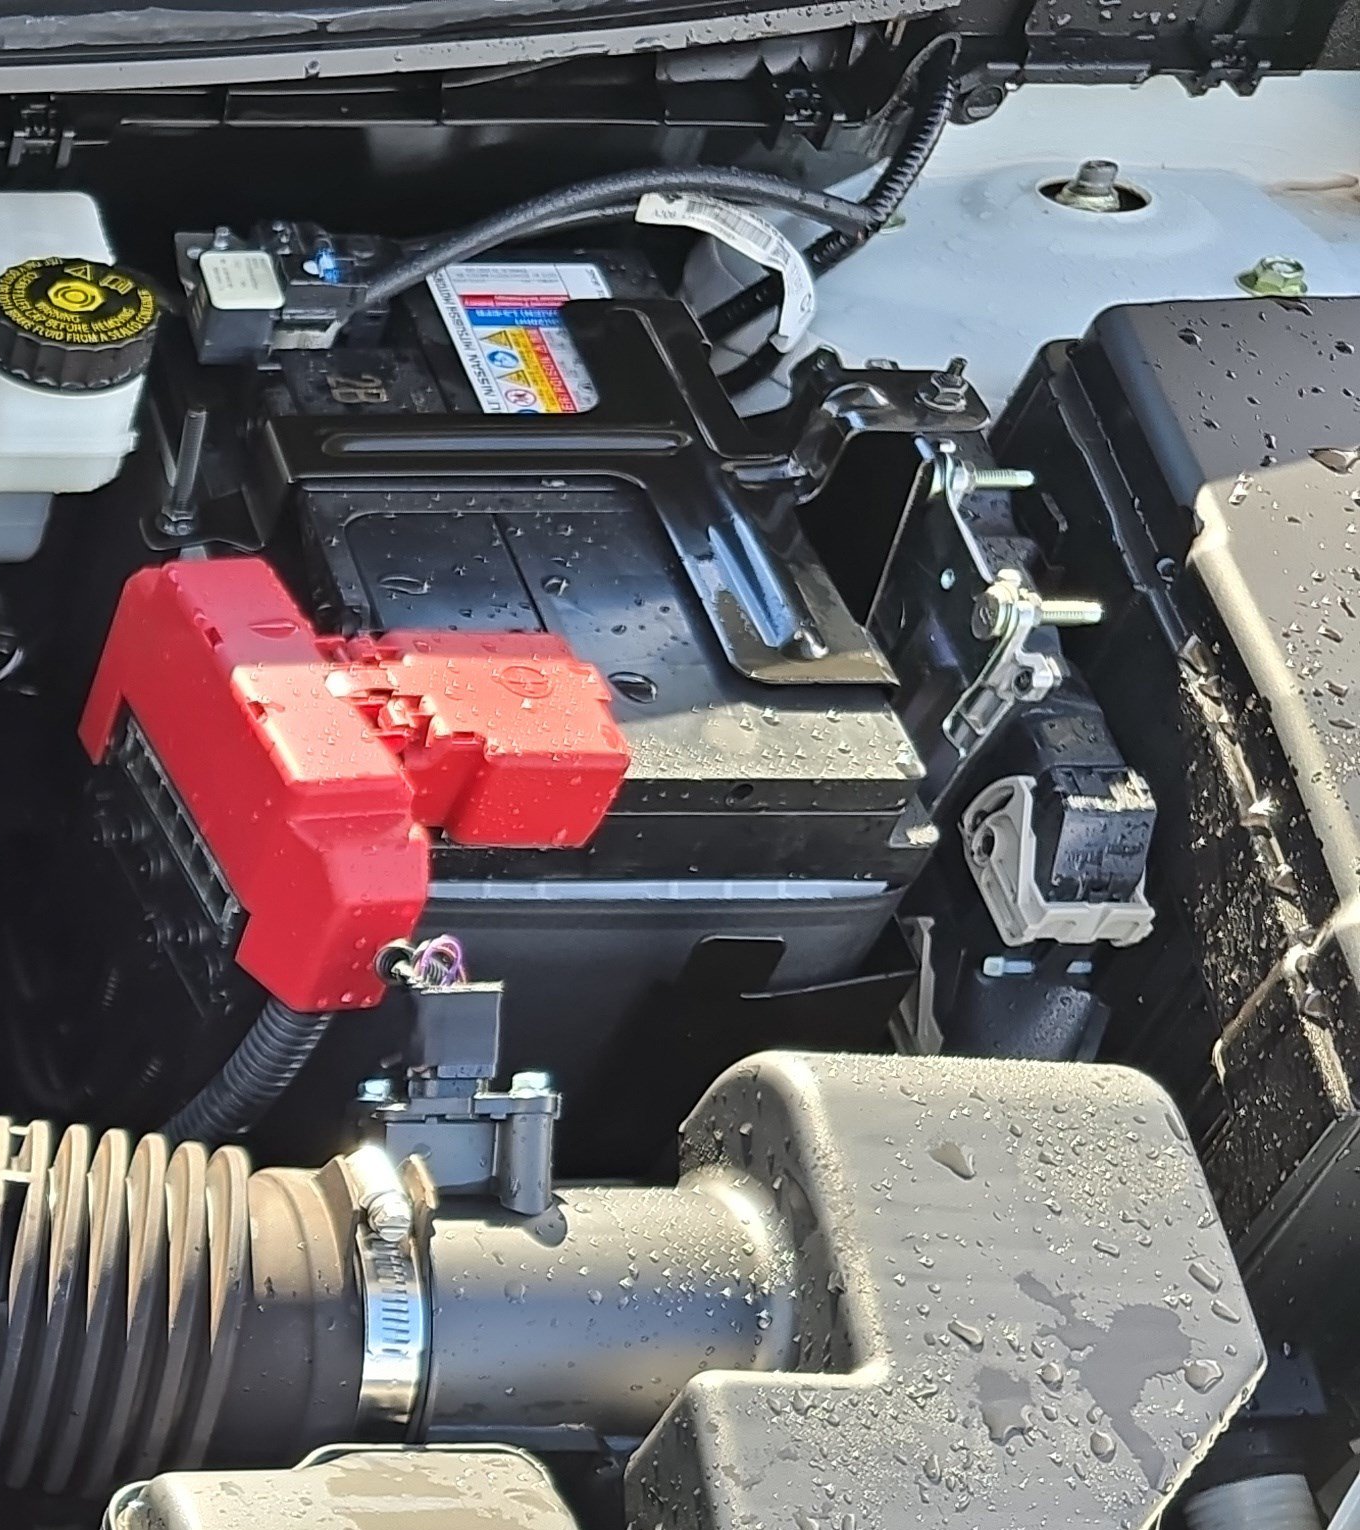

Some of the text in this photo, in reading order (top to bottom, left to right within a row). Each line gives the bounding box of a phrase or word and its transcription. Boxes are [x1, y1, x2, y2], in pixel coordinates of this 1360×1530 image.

[45, 319, 90, 333] BEFORE
[66, 332, 98, 343] FROM
[100, 332, 109, 342] A
[468, 354, 496, 397] NISSAN
